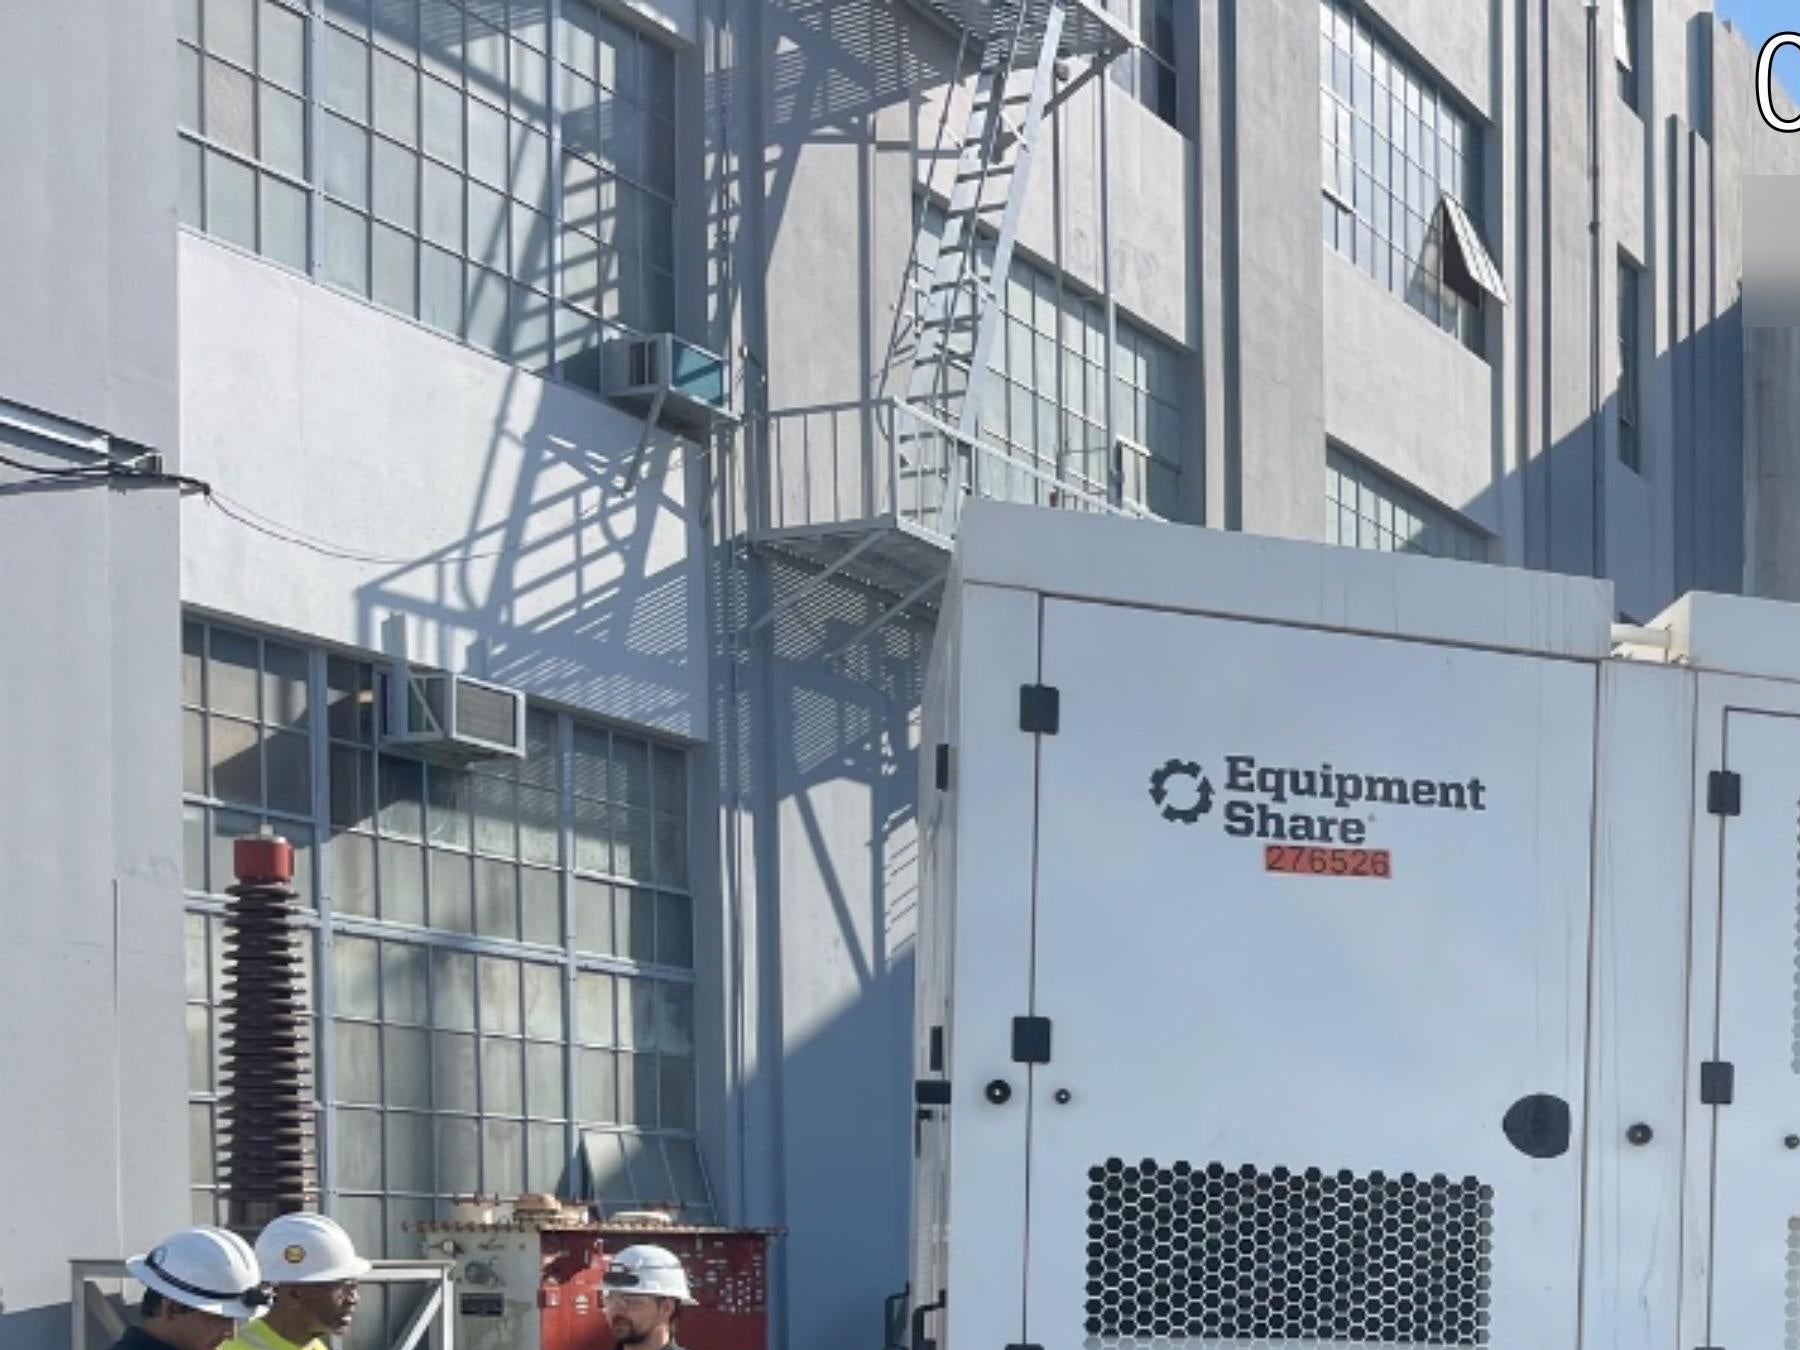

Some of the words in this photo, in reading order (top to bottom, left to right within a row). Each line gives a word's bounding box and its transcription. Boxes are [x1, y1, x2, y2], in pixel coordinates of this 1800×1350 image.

[1224, 756, 1486, 811] Equipment
[1224, 801, 1366, 845] Share
[1266, 846, 1390, 877] 276526
